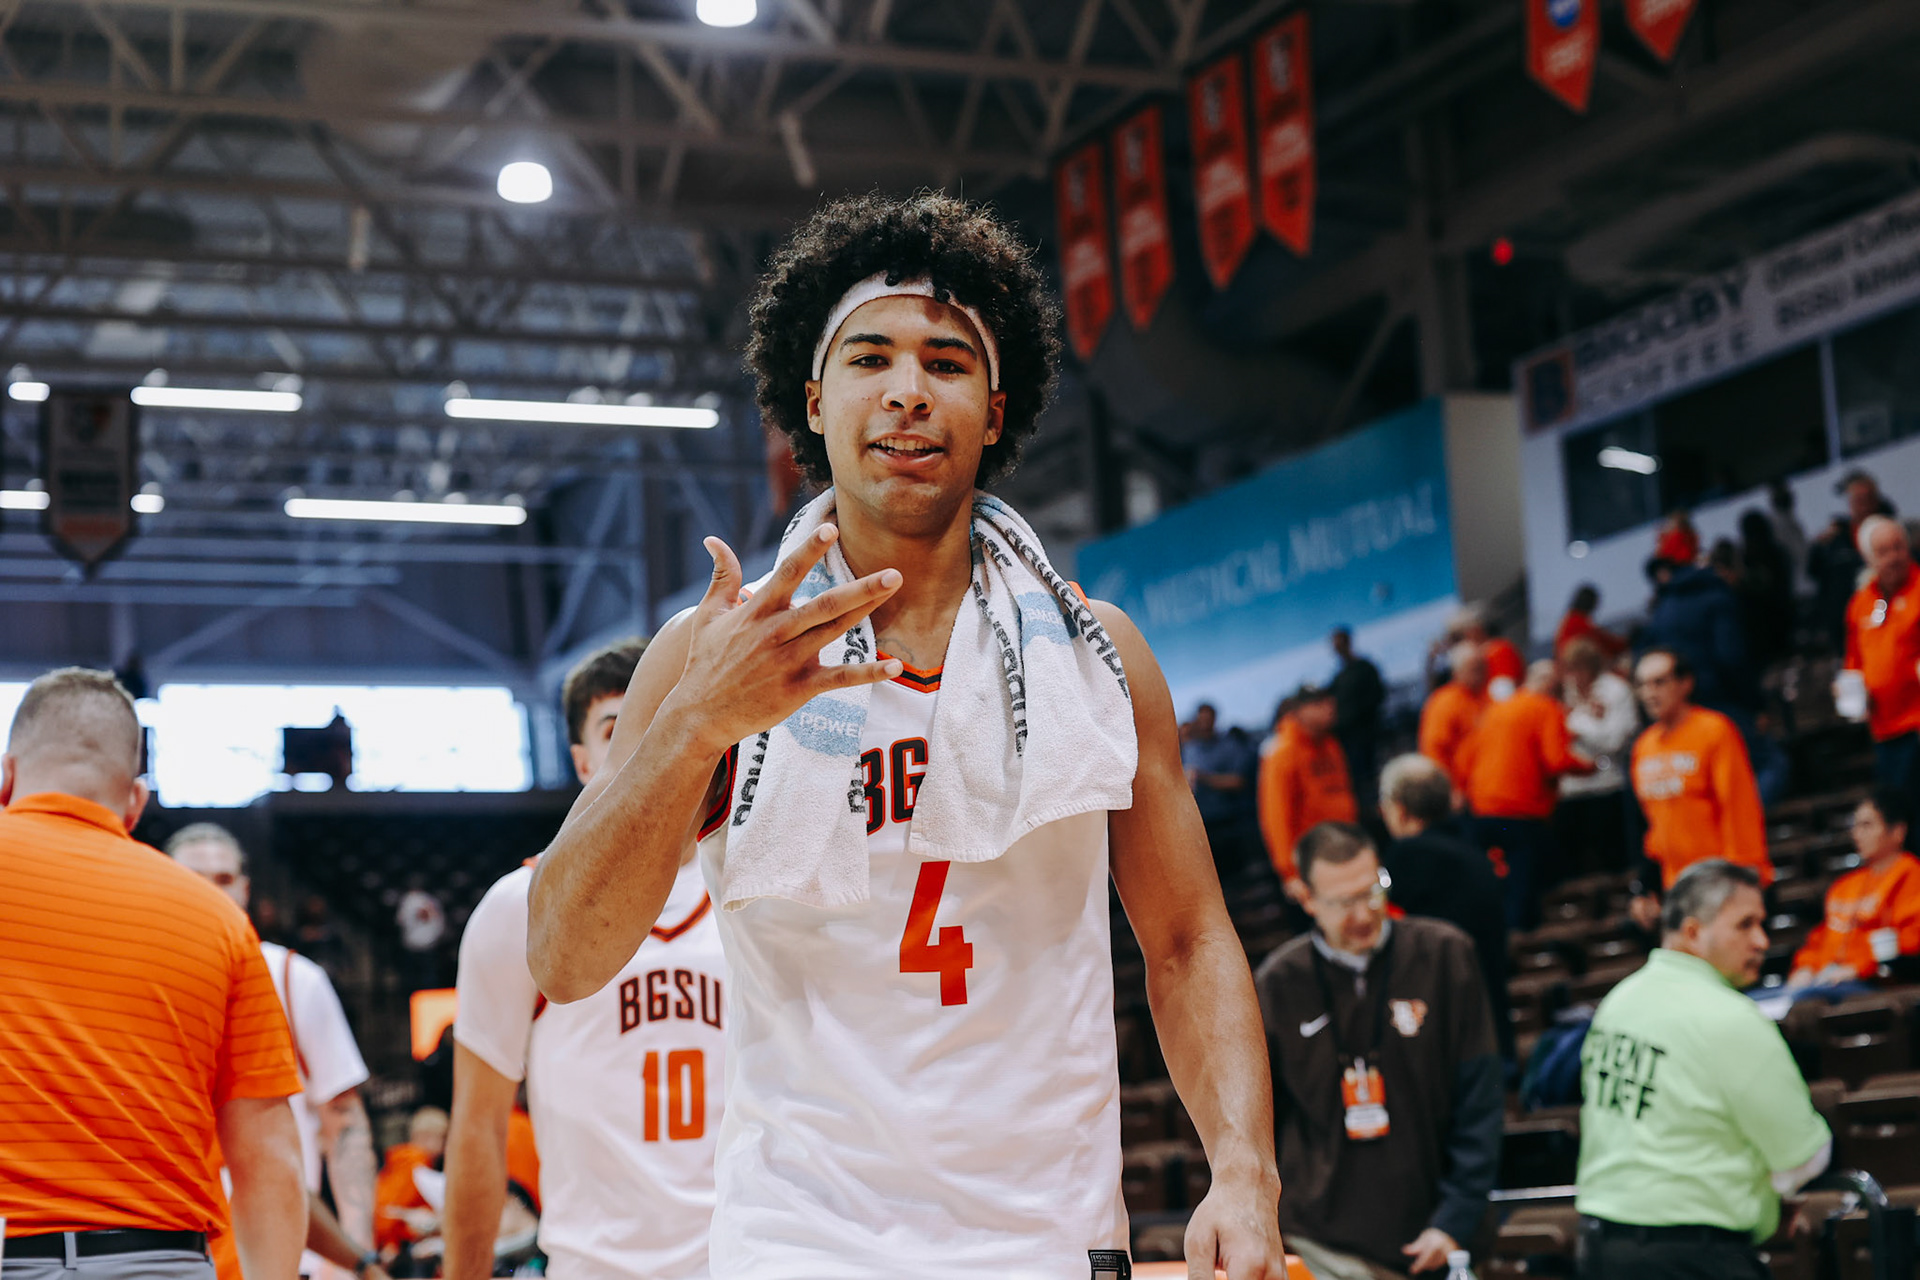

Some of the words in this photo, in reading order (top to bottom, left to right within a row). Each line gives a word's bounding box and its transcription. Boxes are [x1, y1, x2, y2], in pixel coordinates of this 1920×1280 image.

[800, 711, 863, 738] POWE
[899, 860, 973, 1006] 4
[619, 968, 723, 1035] BGSU
[642, 1048, 705, 1142] 10
[1584, 1070, 1656, 1120] TAFF
